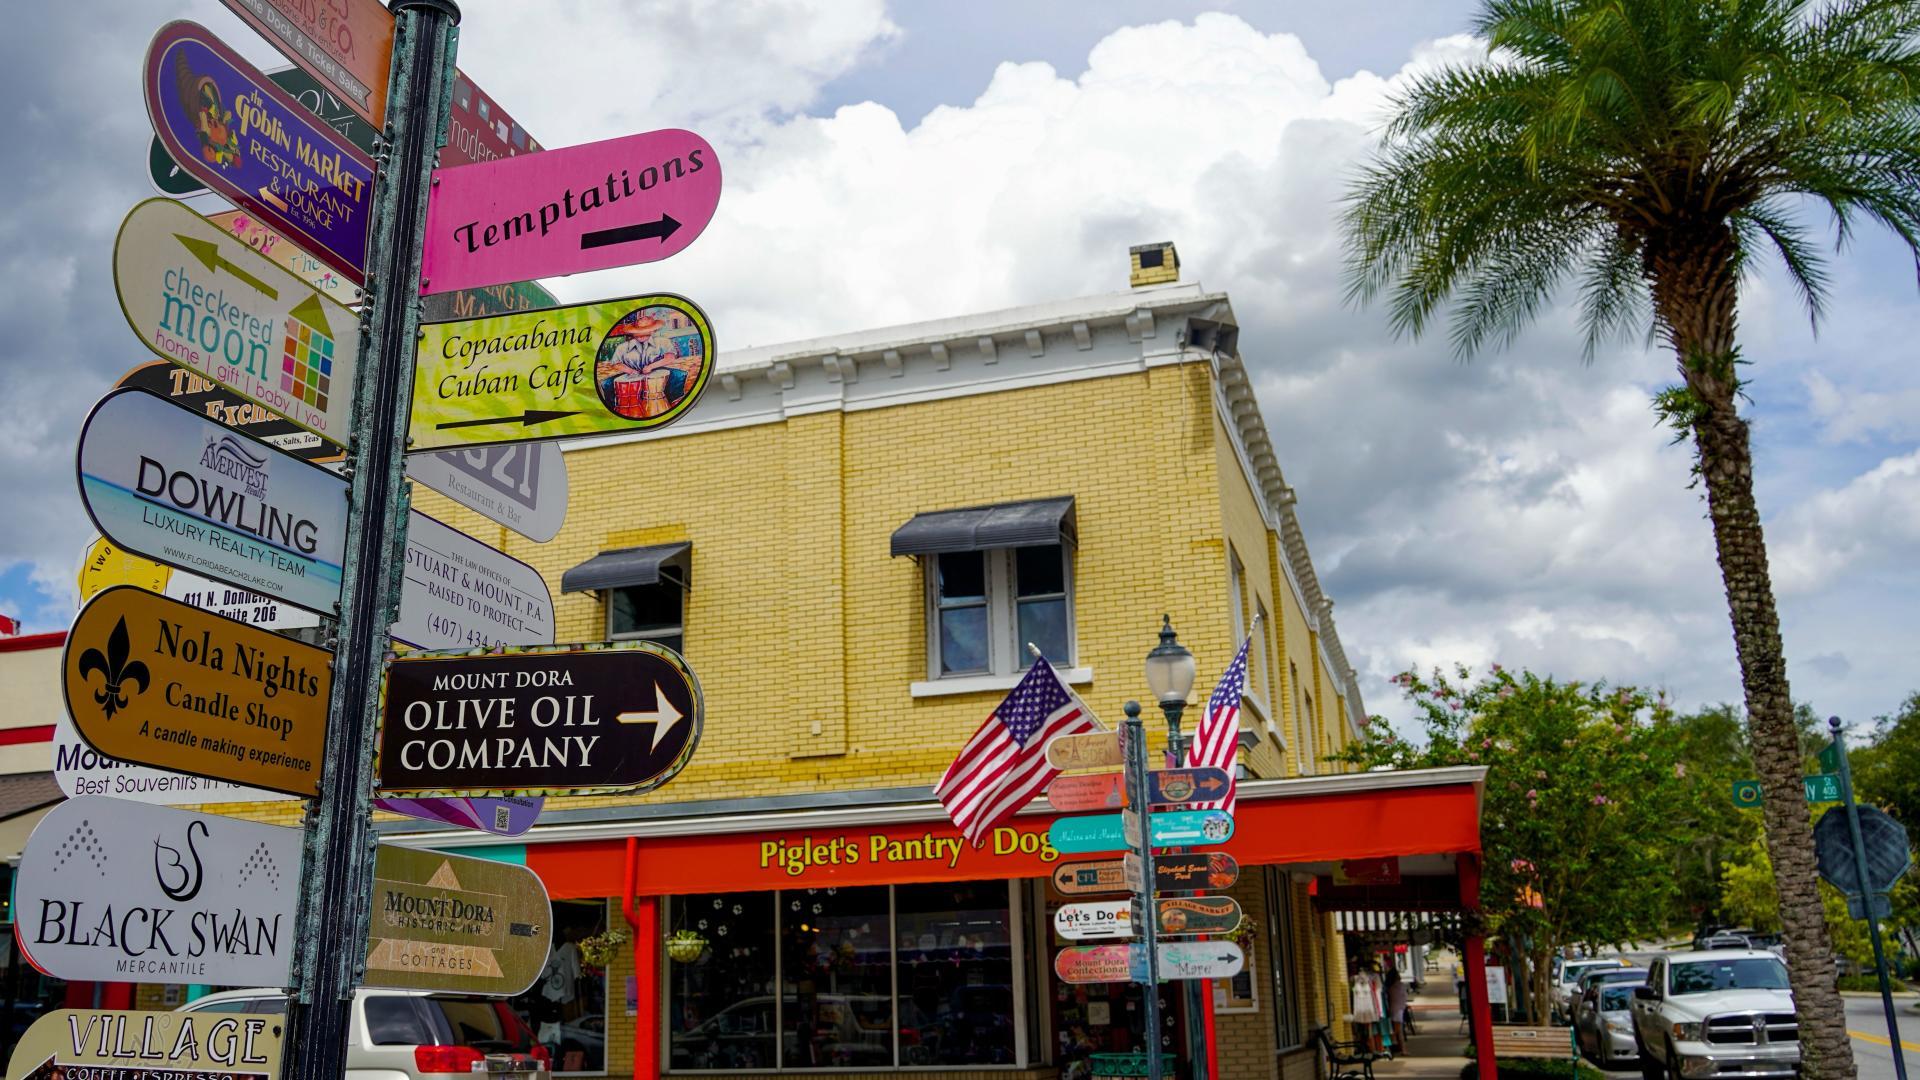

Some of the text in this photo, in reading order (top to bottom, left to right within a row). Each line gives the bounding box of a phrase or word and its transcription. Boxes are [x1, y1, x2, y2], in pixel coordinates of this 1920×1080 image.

[266, 9, 292, 40] Dock
[295, 35, 305, 49] &
[307, 43, 336, 76] Ticket
[338, 71, 364, 100] Sales
[250, 139, 354, 223] RESTAURANT
[270, 176, 333, 231] & LOUNGE
[453, 148, 705, 253] Temptations
[164, 267, 274, 345] checkered
[159, 291, 268, 382] moon
[442, 319, 593, 370] Copacabana
[155, 329, 327, 430] home gift baby you
[438, 354, 586, 401] Cuban Café
[135, 455, 318, 553] DOWLING
[448, 474, 522, 524] Restaurant & Bar
[406, 547, 459, 583] STUART
[461, 572, 470, 590] &
[473, 579, 523, 613] MOUNT,
[253, 606, 277, 623] 206
[427, 613, 463, 644] (407)
[428, 582, 523, 632] RAISED TO PROTECT
[155, 618, 319, 698] Nola Nights
[433, 669, 574, 691] MOUNT DORA
[165, 681, 293, 741] Candle Shop
[403, 695, 600, 731] OLIVE OIL
[139, 720, 311, 772] A candle making experience
[400, 735, 600, 771] COMPANY
[75, 776, 110, 795] Best
[115, 774, 197, 793] Souvenirs
[760, 835, 859, 876] Piglet's
[869, 832, 964, 868] Pantry
[34, 898, 283, 960] BLACK SWAN
[398, 916, 455, 933] HISTORIC
[1058, 909, 1114, 923] Let's Do
[116, 959, 206, 976] MERCANTILE
[400, 953, 473, 970] COTTAGES
[68, 1014, 267, 1067] VILLAGE
